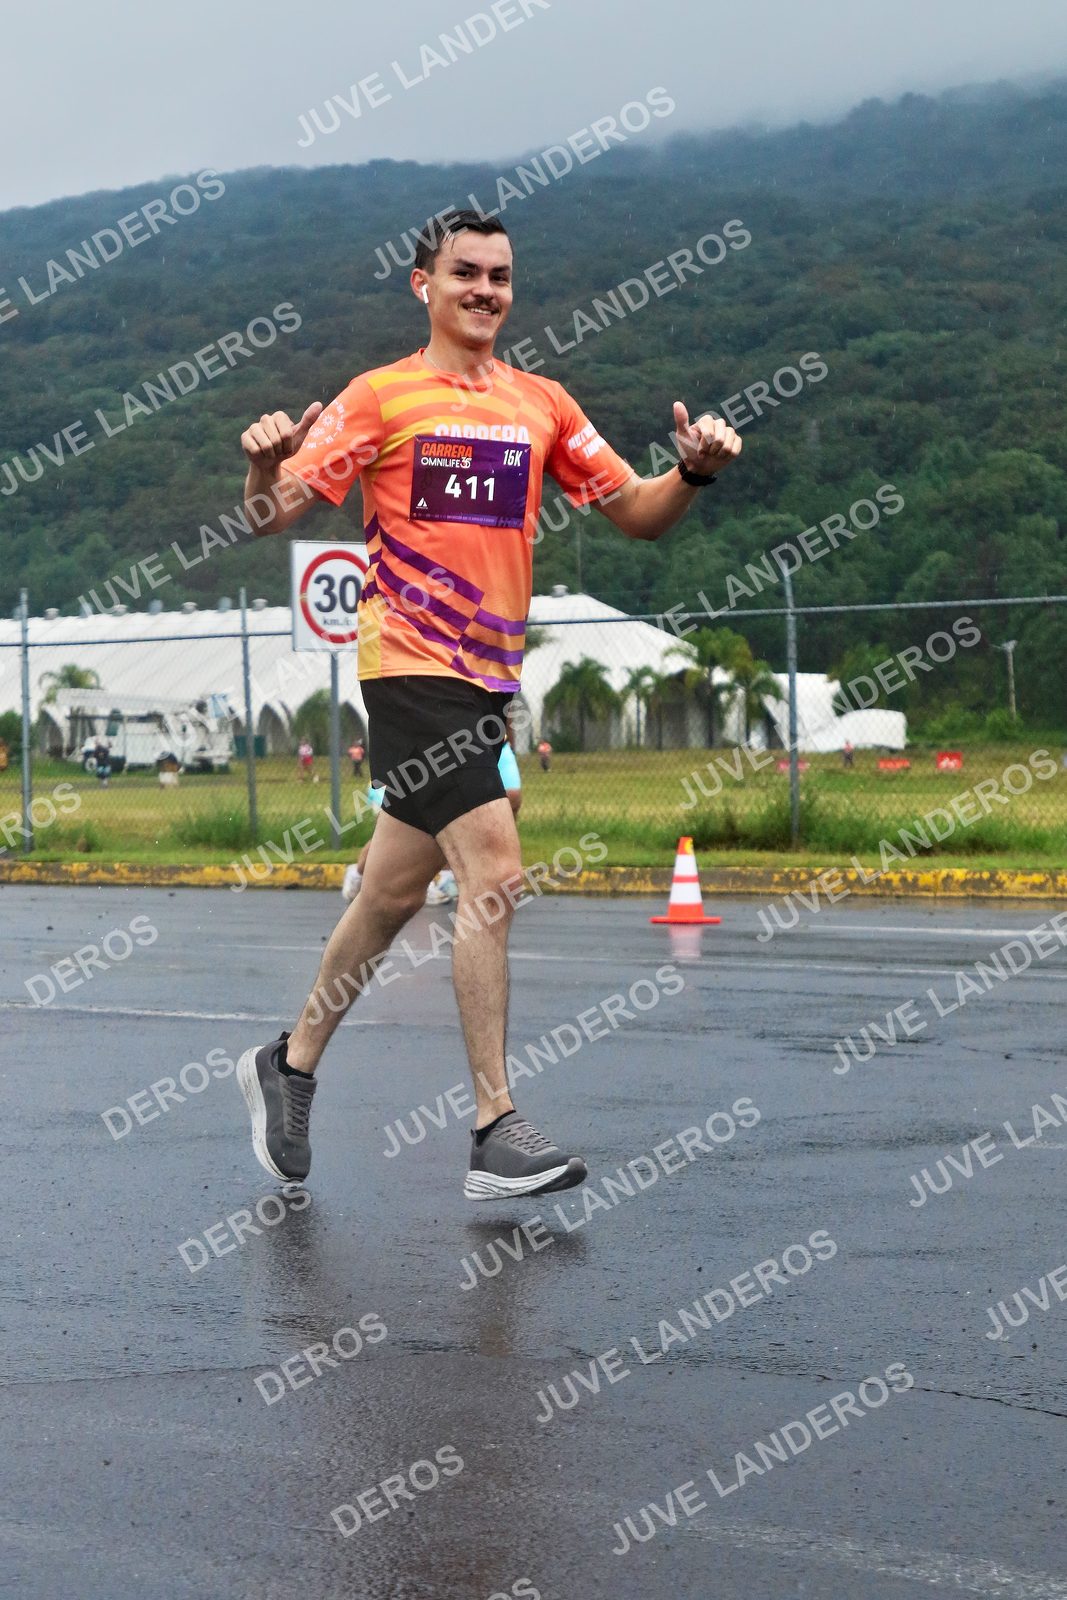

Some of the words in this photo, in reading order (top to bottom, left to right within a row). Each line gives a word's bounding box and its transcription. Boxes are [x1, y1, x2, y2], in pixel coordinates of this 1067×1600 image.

[421, 442, 473, 458] CARRERA
[503, 449, 522, 466] 15K
[444, 473, 496, 501] 411
[313, 573, 362, 613] 30
